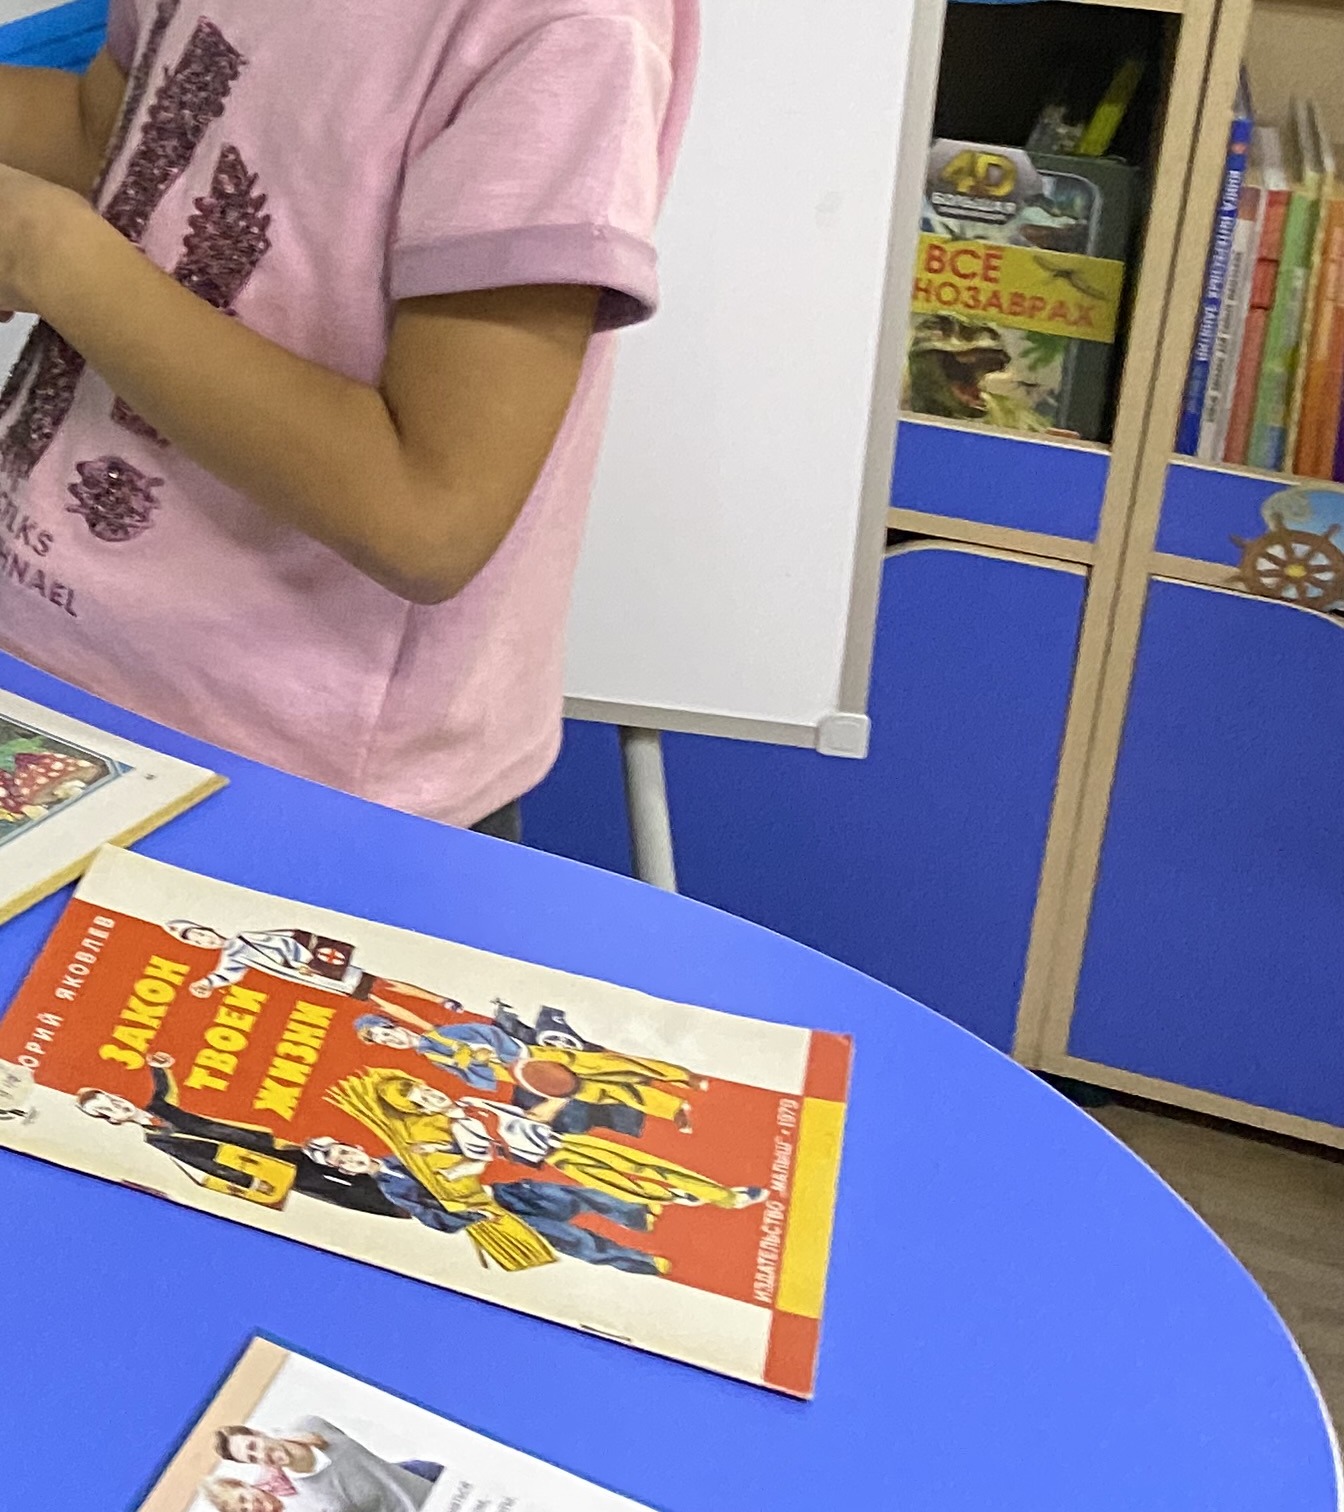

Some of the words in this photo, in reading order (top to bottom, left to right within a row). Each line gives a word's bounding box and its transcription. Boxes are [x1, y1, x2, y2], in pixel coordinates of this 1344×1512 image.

[940, 149, 1018, 198] 4D
[924, 243, 1004, 284] ВСЕ
[55, 914, 116, 1002] ЯКОВЛЕВ
[98, 953, 192, 1071] ЗАКОН
[183, 983, 270, 1092] ТВОЕЙ
[252, 998, 337, 1122] ЖИЗНИ
[753, 1200, 786, 1304] ИЗДАТЕЛЬСТВО
